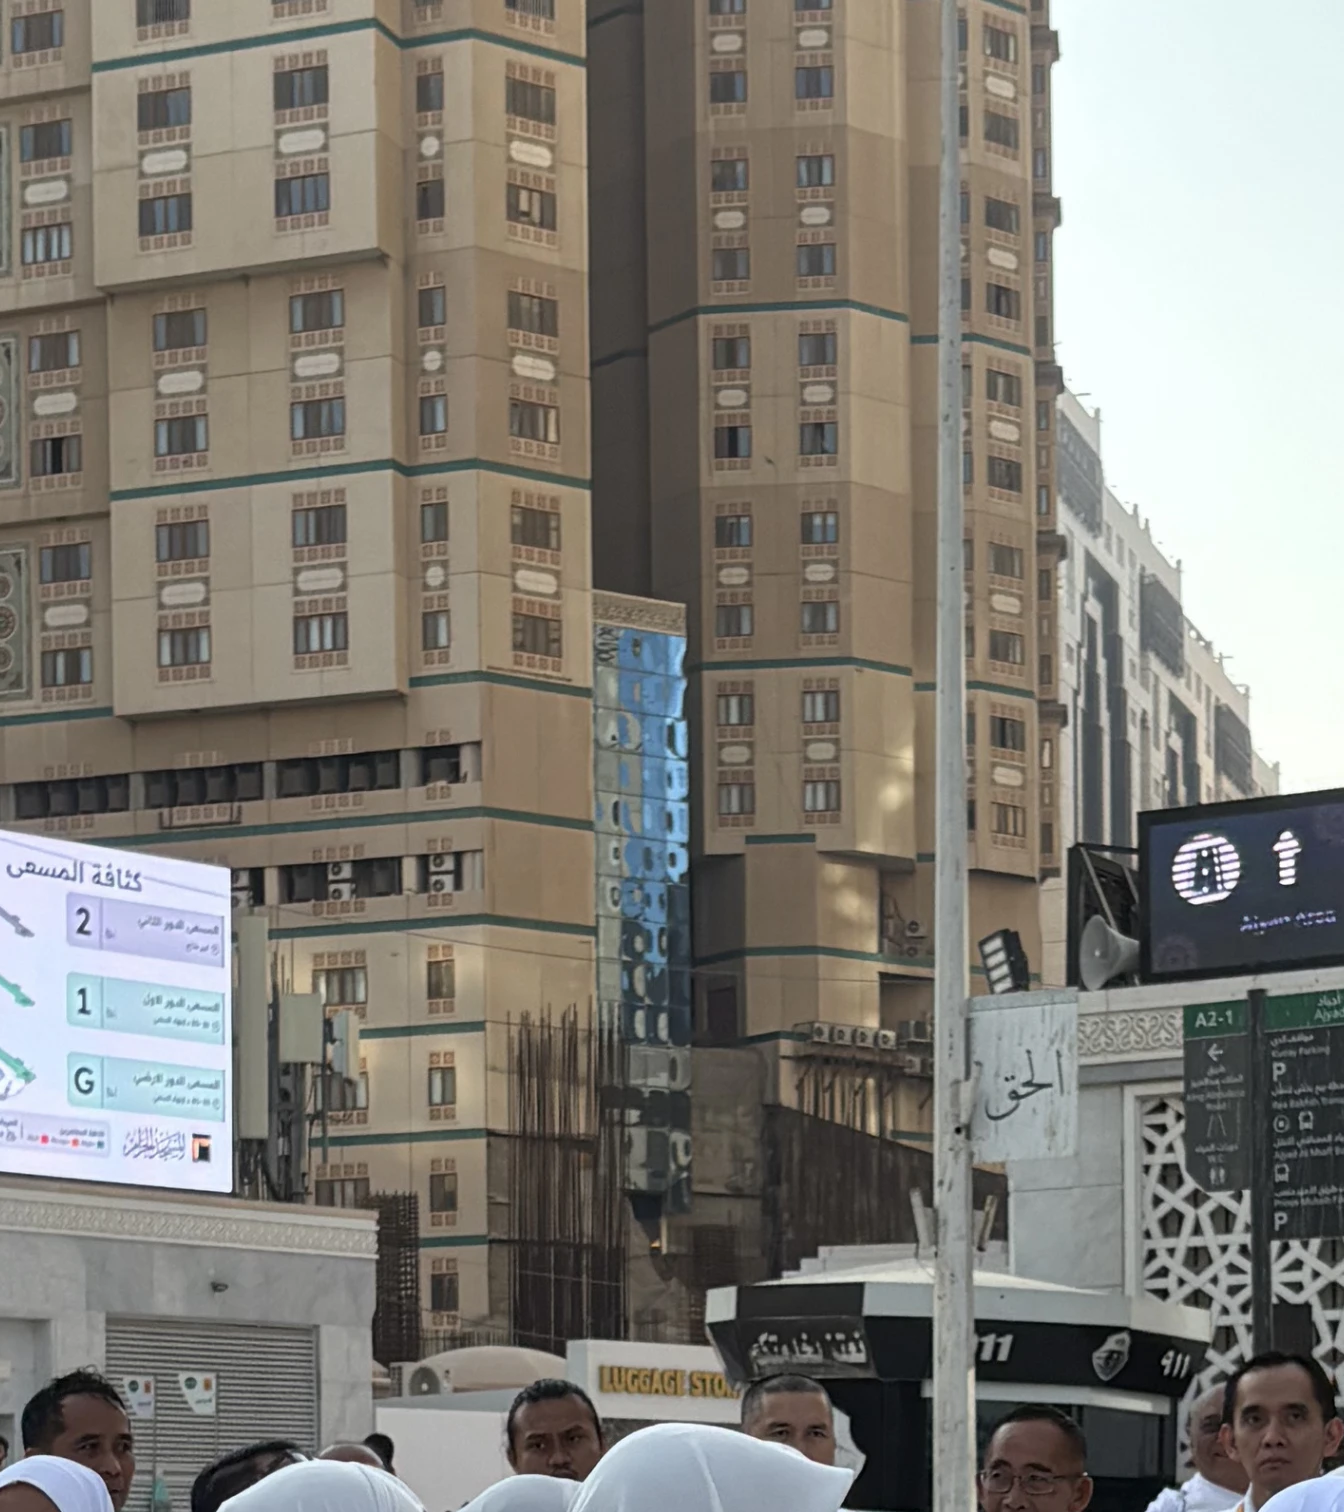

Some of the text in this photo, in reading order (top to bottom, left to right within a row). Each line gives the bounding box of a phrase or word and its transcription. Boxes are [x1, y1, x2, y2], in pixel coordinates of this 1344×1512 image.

[6, 861, 143, 892] كثافة المسعى
[75, 907, 92, 936] 2
[77, 987, 92, 1016] 1
[1195, 1009, 1233, 1028] A2-1
[74, 1066, 95, 1096] G
[984, 1048, 1065, 1121] الحق
[1272, 1062, 1287, 1082] P
[1274, 1212, 1288, 1232] P
[977, 1333, 1014, 1362] 11
[1160, 1349, 1191, 1380] 911
[599, 1365, 686, 1396] LUGGAGE
